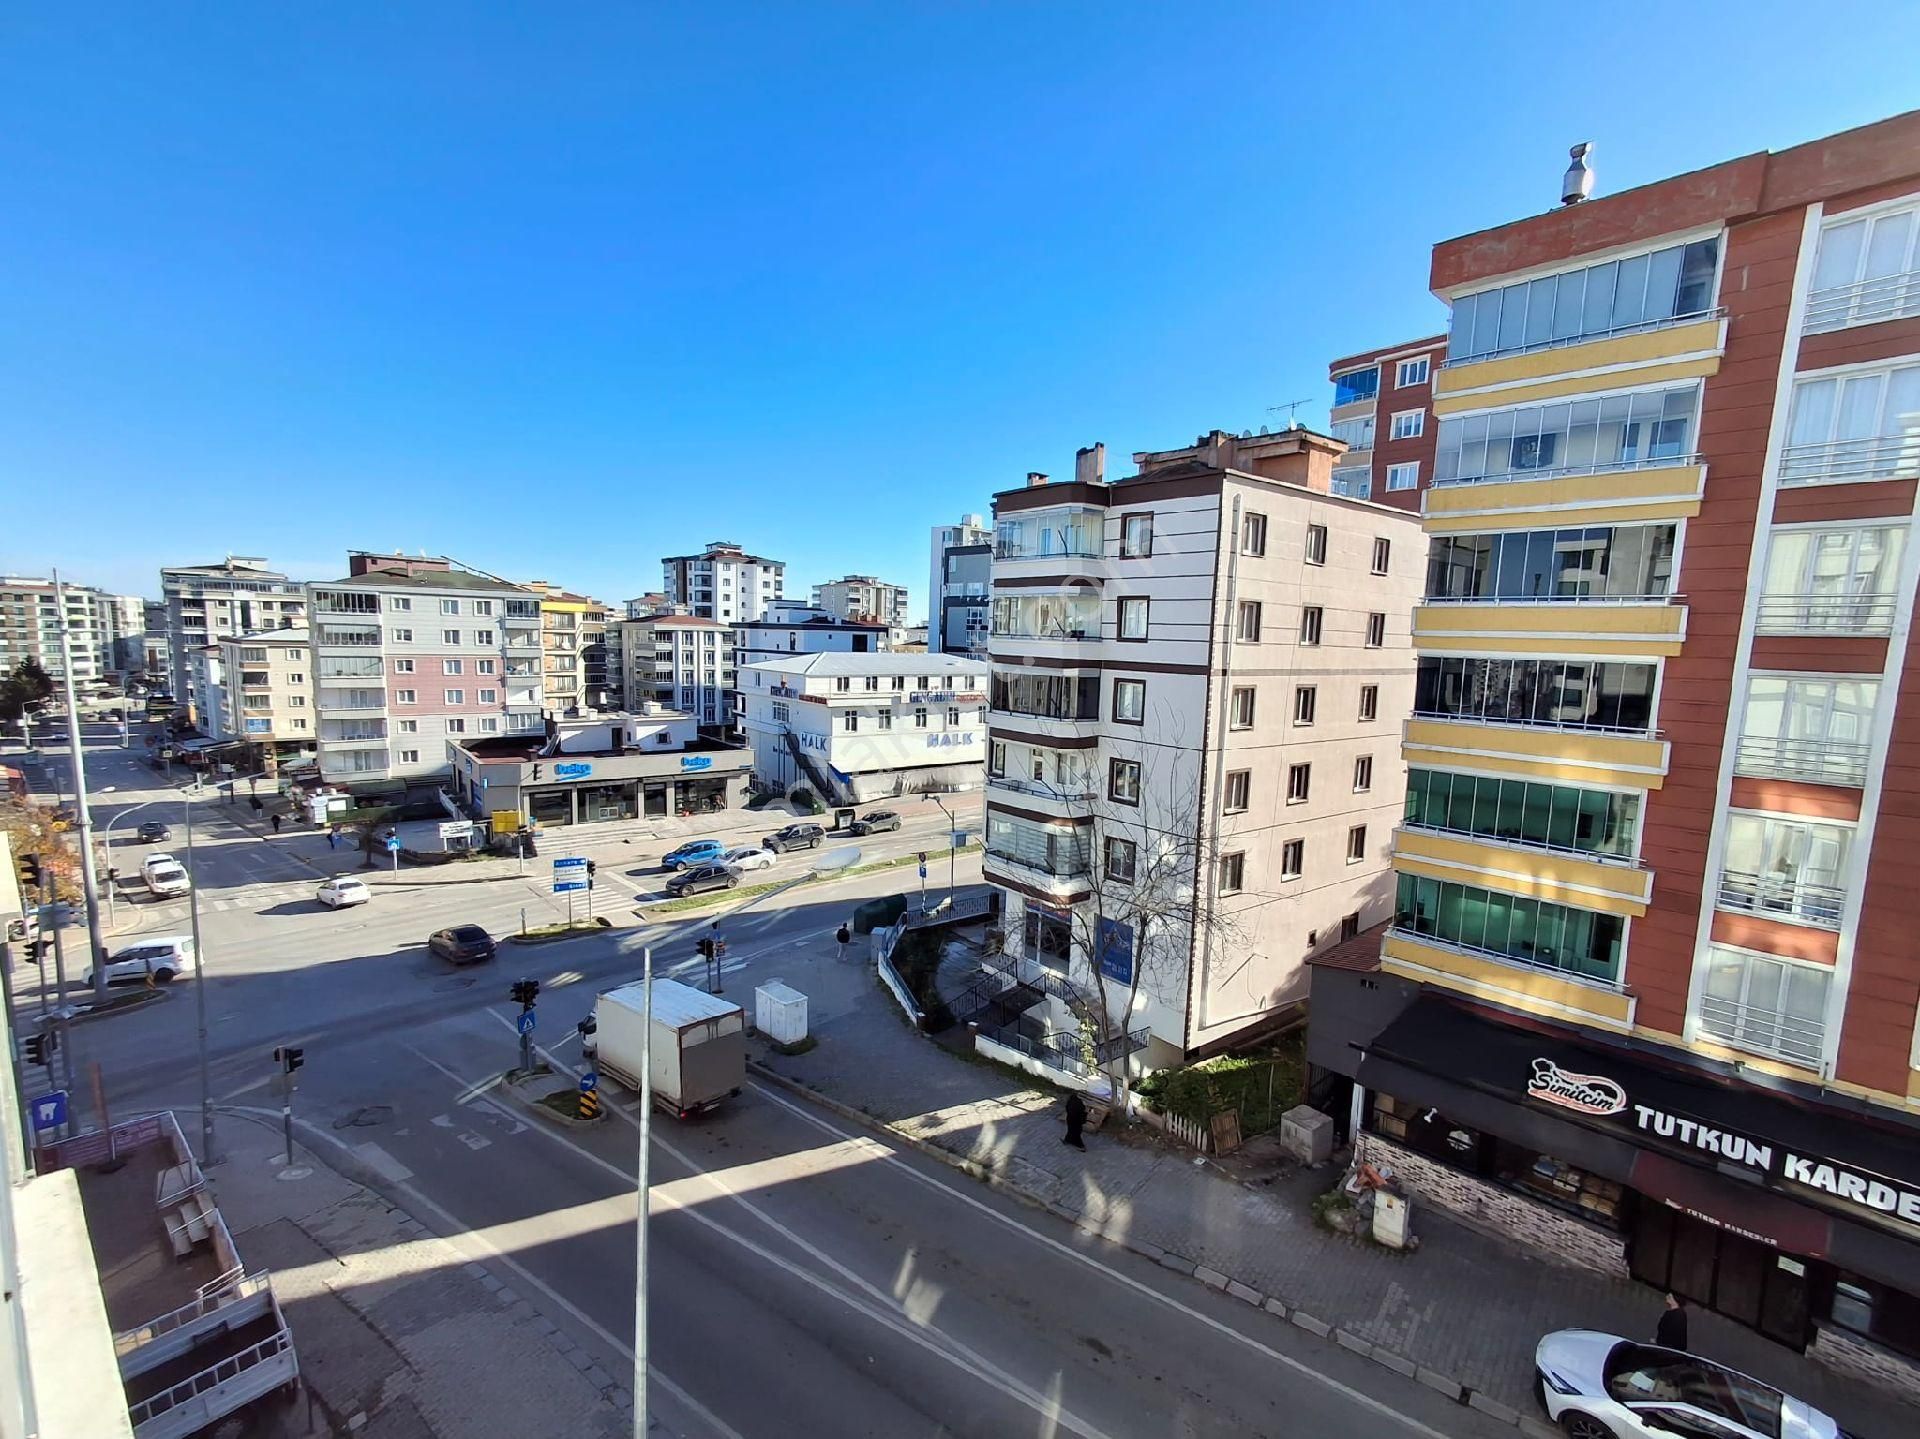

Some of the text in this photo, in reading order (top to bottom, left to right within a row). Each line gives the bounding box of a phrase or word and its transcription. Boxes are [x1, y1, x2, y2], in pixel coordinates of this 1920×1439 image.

[801, 732, 828, 752] HALK
[926, 732, 973, 748] HALK
[1635, 1105, 1771, 1170] TUTKUN
